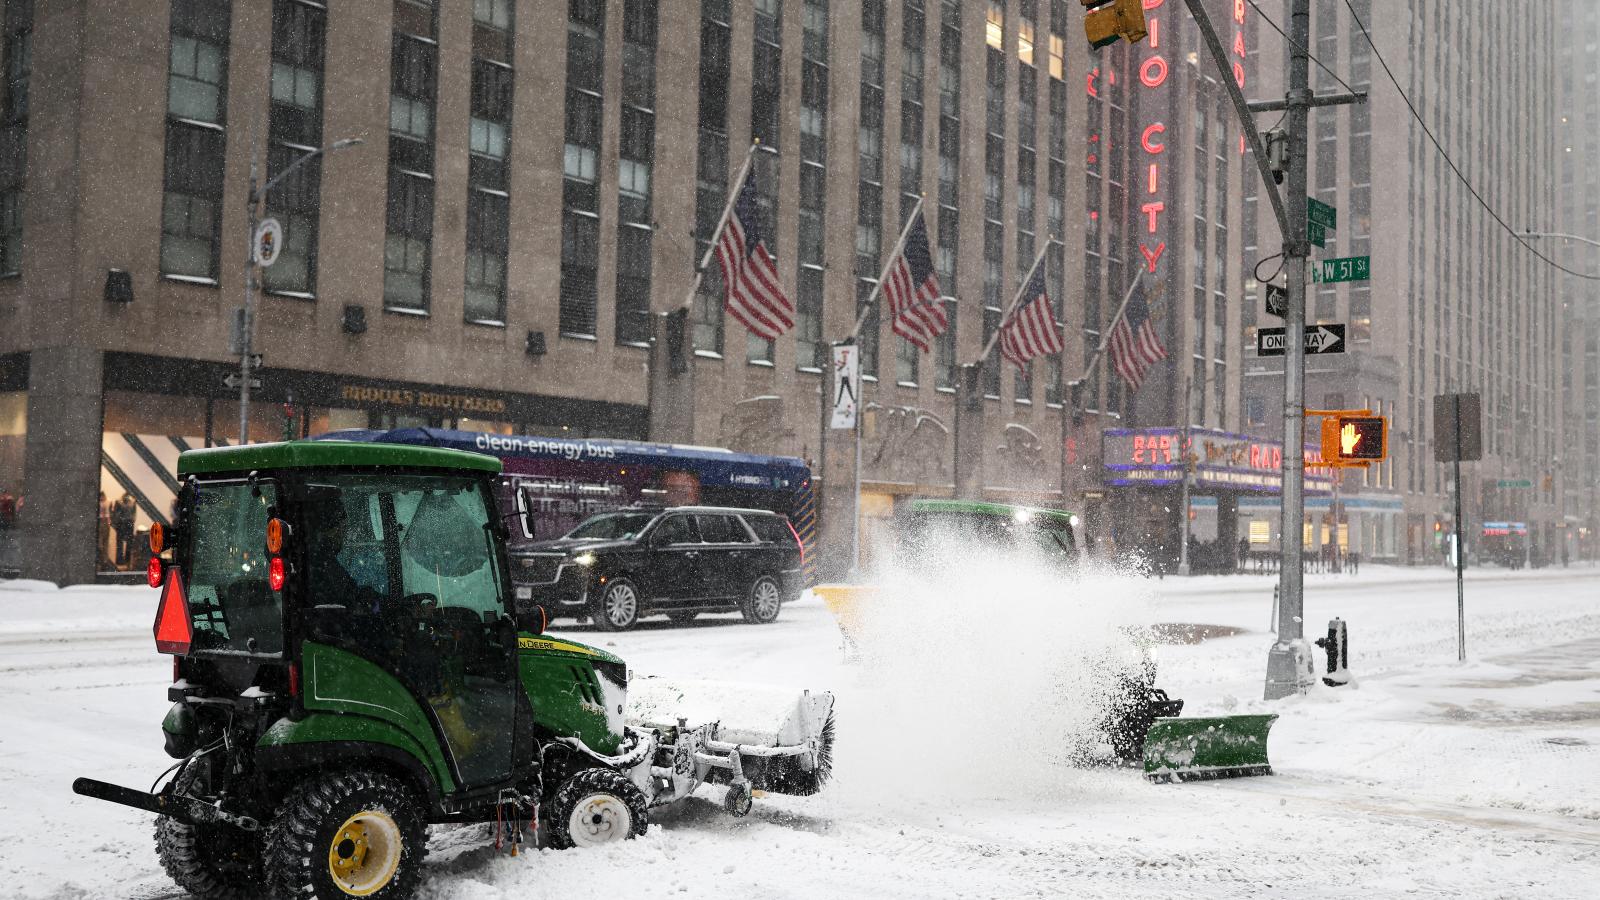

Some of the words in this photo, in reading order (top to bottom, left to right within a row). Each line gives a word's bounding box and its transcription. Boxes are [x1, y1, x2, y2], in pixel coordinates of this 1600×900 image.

[1139, 122, 1168, 272] CITY
[1325, 262, 1335, 280] W
[1341, 261, 1353, 279] 51
[1357, 259, 1366, 271] St
[475, 433, 583, 460] clean-energy
[587, 441, 615, 458] bus
[1250, 443, 1282, 470] RAD
[528, 640, 554, 649] DEERE
